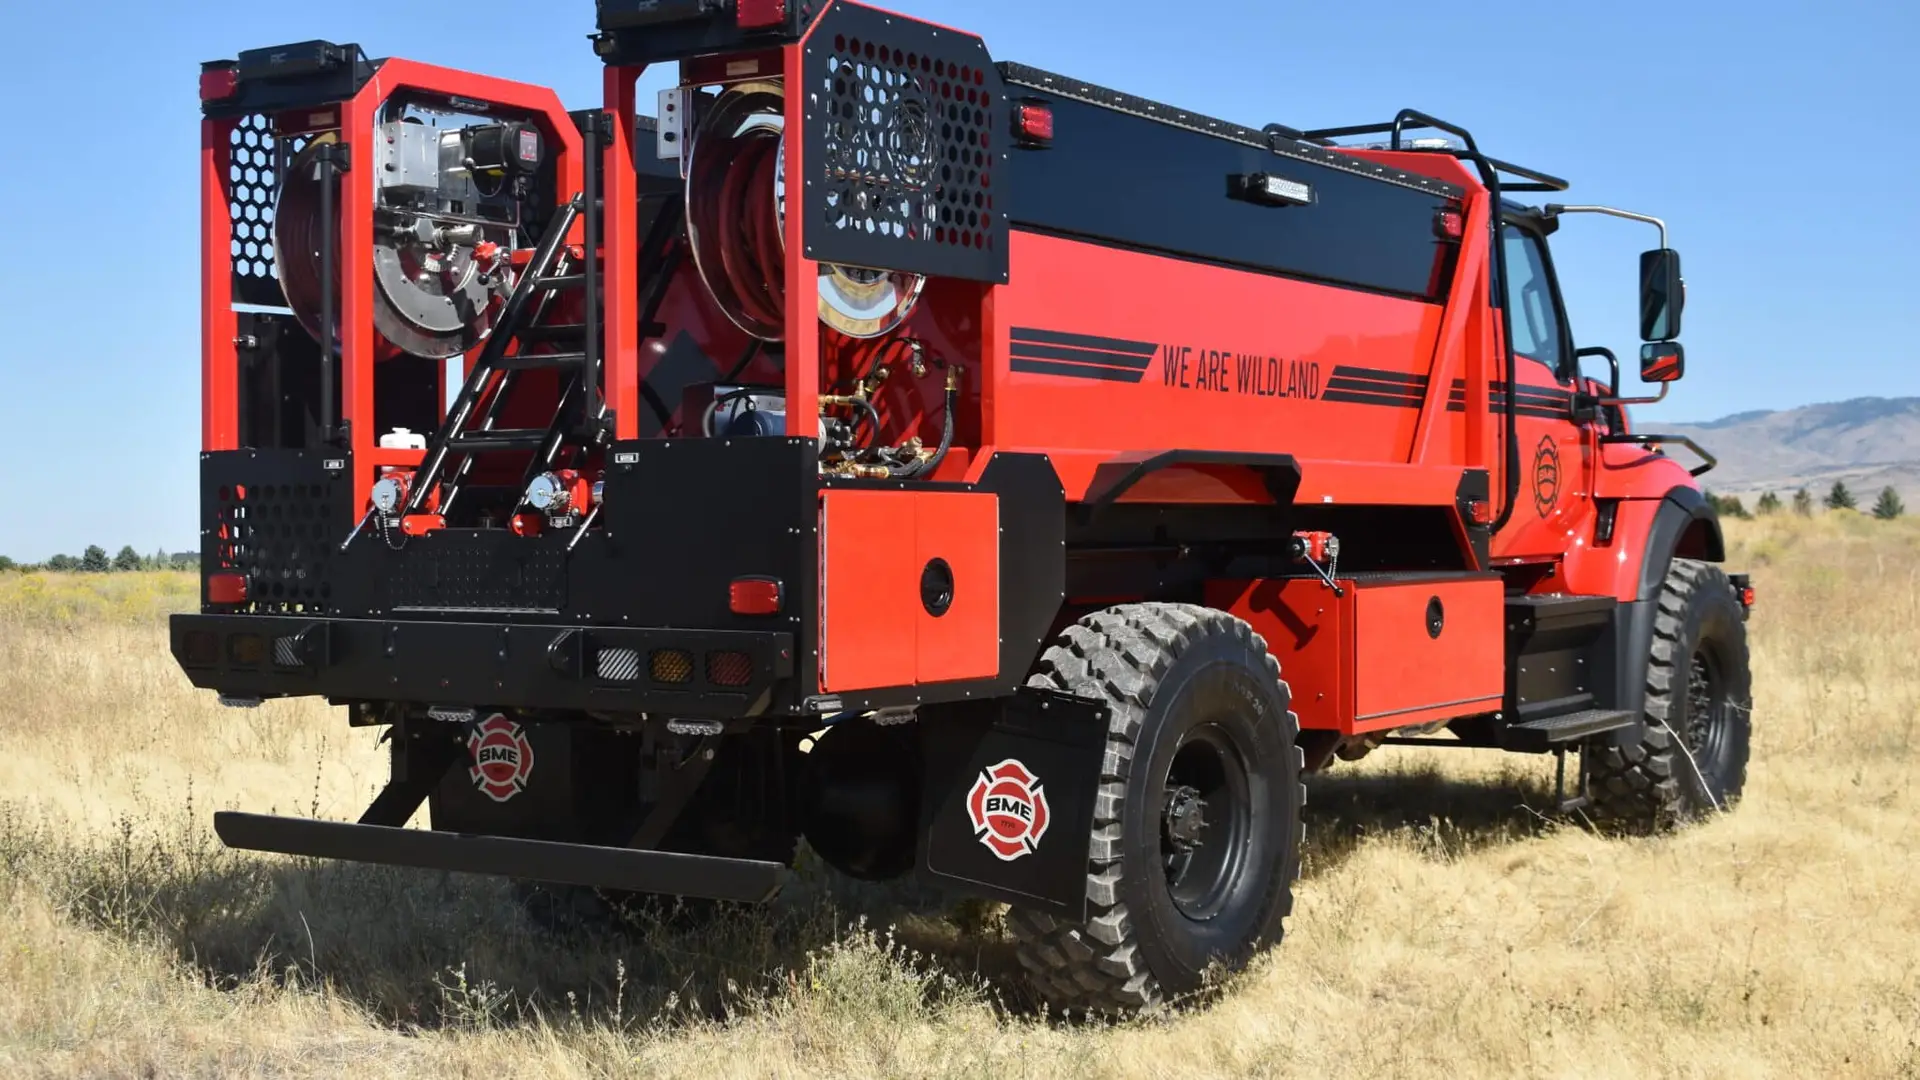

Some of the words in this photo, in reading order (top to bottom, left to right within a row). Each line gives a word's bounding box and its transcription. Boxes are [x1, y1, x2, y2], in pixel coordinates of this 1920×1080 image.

[1163, 344, 1192, 388] WE
[1196, 349, 1231, 392] ARE
[1236, 353, 1319, 400] WILDLAND
[479, 748, 518, 764] BME
[986, 797, 1032, 822] BME
